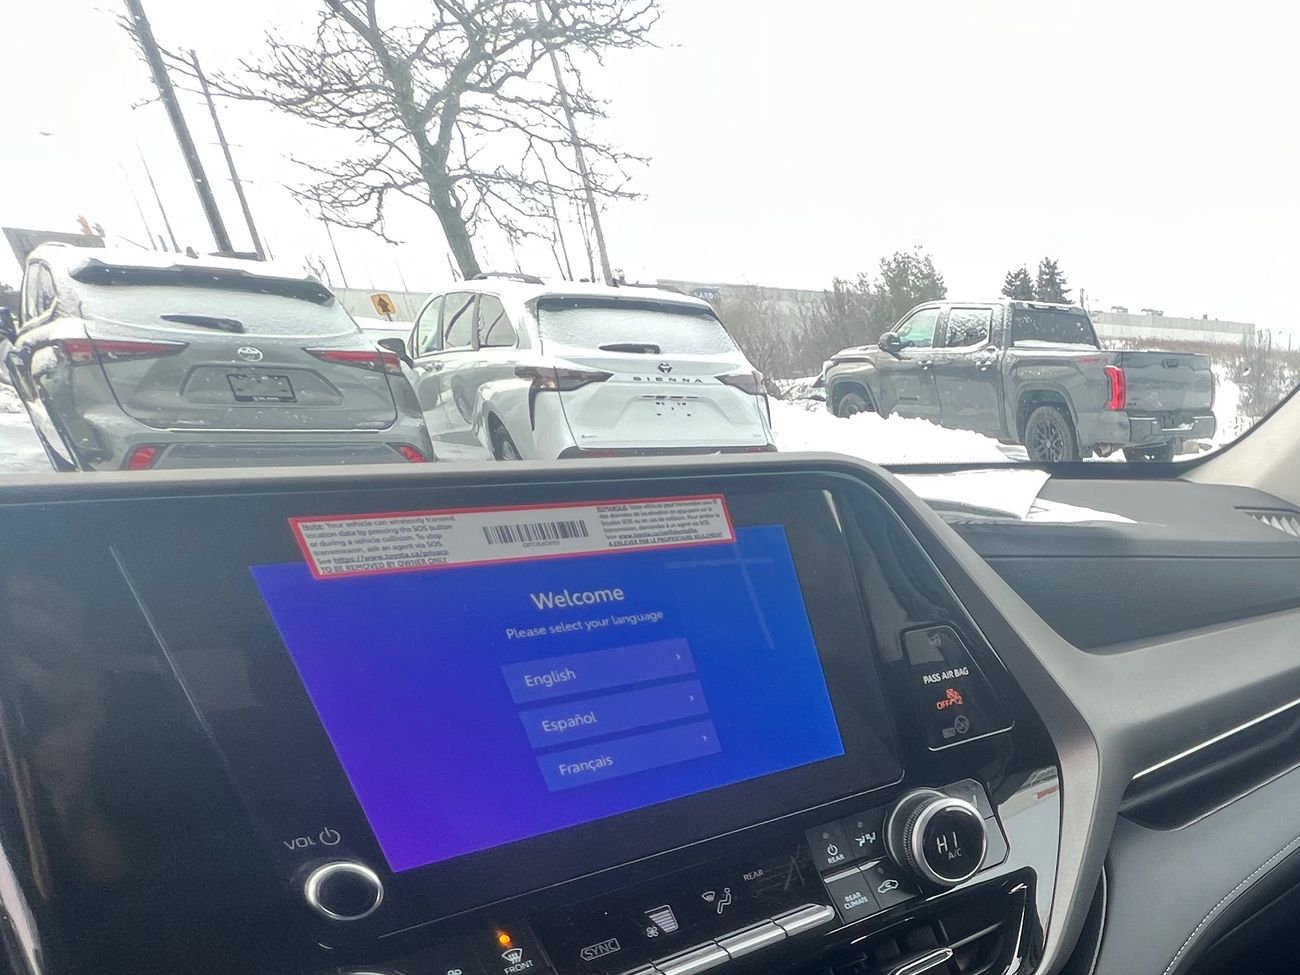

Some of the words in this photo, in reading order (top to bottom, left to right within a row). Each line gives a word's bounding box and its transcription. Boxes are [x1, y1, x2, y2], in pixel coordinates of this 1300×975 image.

[530, 587, 625, 610] Welcome
[506, 626, 547, 640] Please
[549, 619, 583, 634] select
[584, 618, 610, 632] your
[611, 610, 664, 626] language
[524, 668, 576, 688] English
[923, 673, 941, 684] PASS
[942, 669, 955, 680] AIR
[954, 667, 969, 677] BAG
[542, 711, 598, 733] Español
[558, 755, 614, 776] Français
[283, 835, 316, 851] VOL
[827, 854, 846, 865] REAR
[948, 848, 963, 860] A/C
[743, 869, 765, 881] REAR
[844, 891, 863, 902] REAR
[844, 895, 869, 910] CLIMATE
[584, 940, 618, 960] SYNC
[504, 959, 534, 975] FRONT
